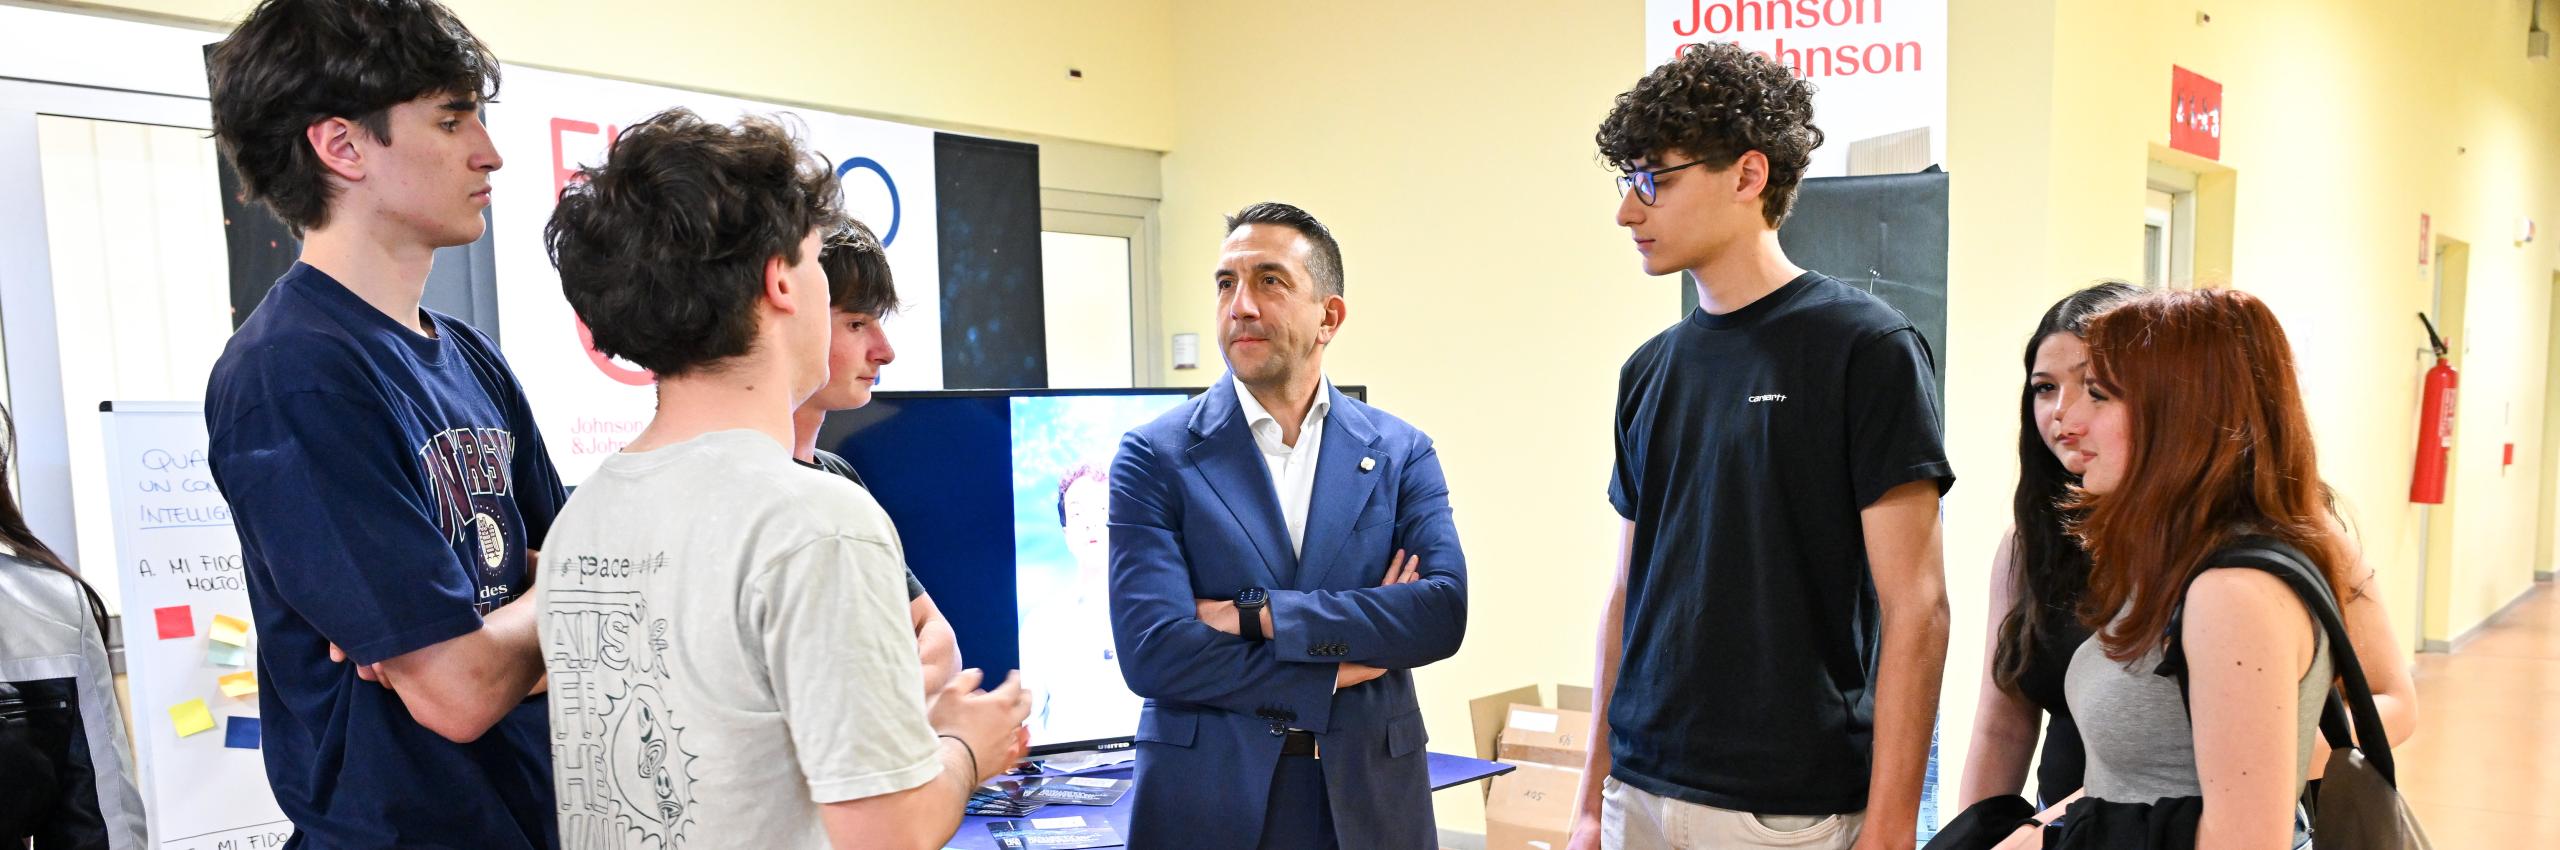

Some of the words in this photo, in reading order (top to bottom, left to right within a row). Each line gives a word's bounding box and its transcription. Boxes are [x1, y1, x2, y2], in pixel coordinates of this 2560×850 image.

[1672, 0, 1882, 36] Johnson
[570, 416, 644, 434] Johnson
[139, 479, 172, 493] UN
[169, 557, 191, 574] MI
[200, 554, 243, 572] FIDO
[1097, 742, 1130, 750] UNITED
[247, 832, 289, 849] FIDO
